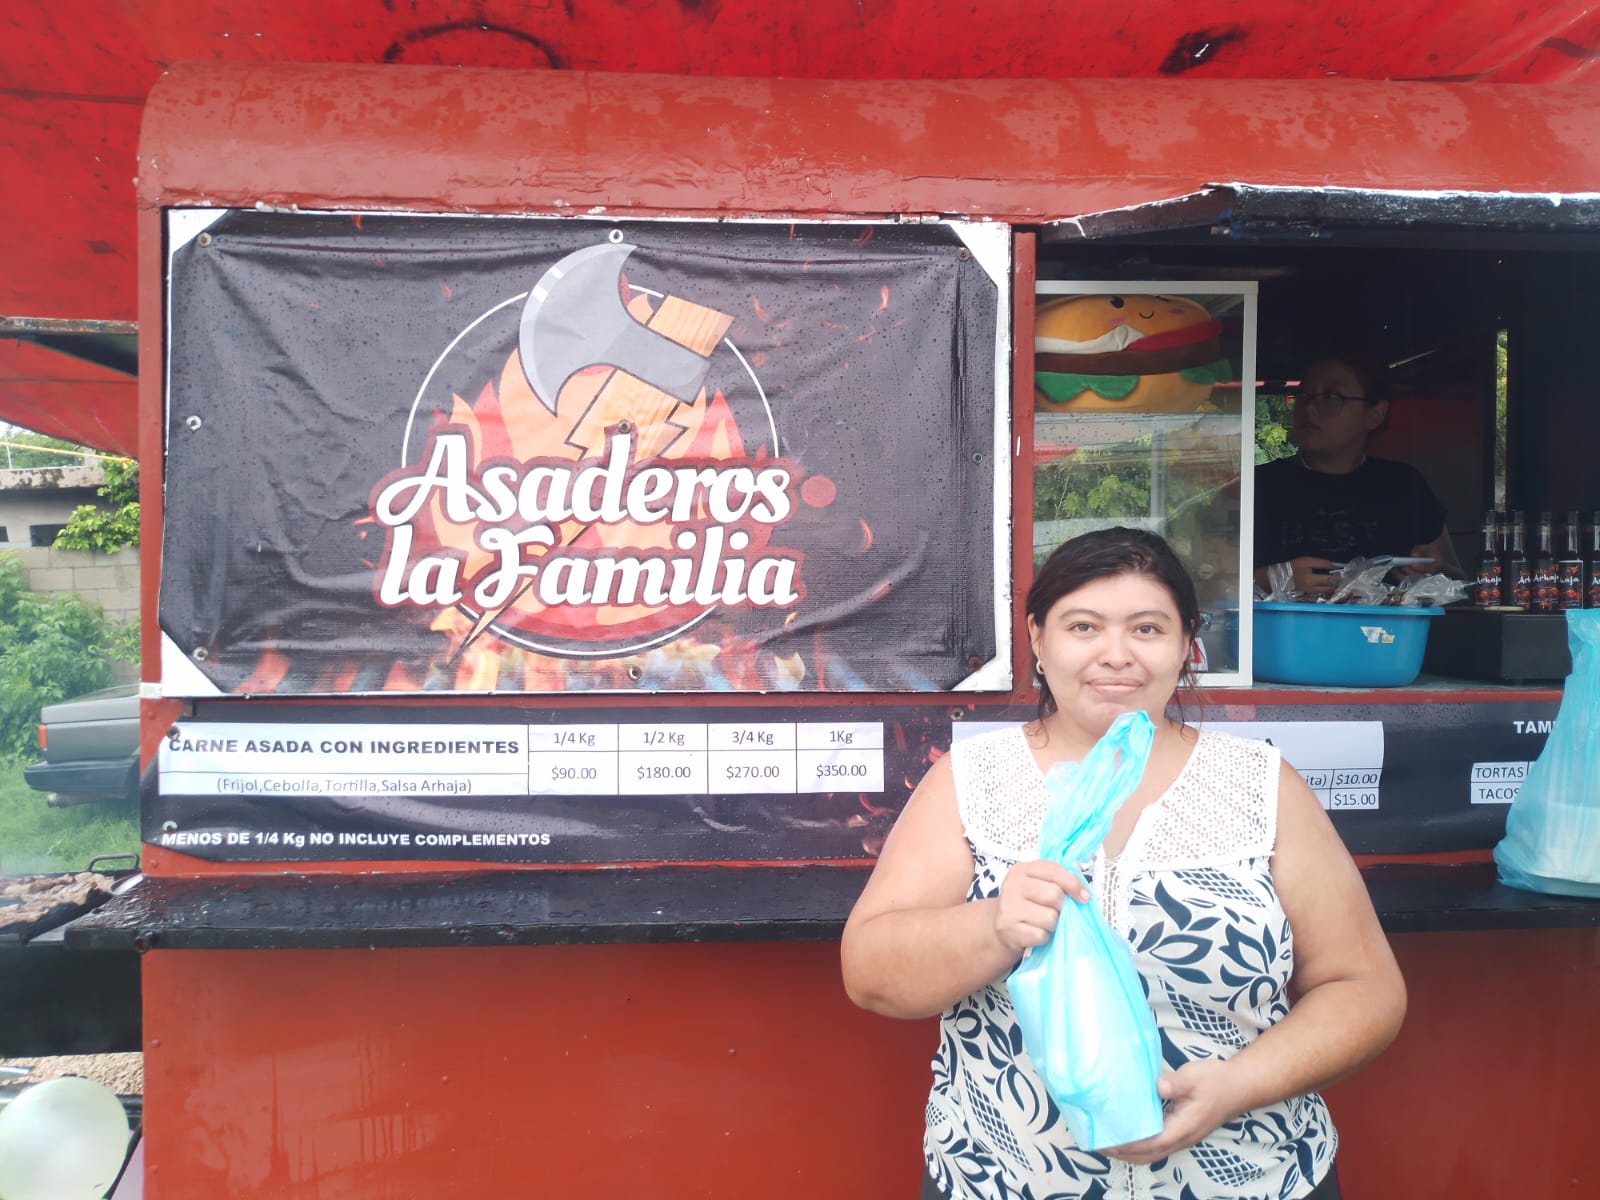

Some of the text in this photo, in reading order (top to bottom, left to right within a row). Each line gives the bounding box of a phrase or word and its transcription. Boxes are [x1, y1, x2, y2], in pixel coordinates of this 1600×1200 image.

[376, 434, 791, 525] Asaderos
[380, 525, 798, 606] la Familia
[1513, 720, 1556, 734] TAM
[553, 732, 595, 747] 1/4 Kg
[643, 732, 685, 747] 1/2 Kg
[732, 731, 774, 746] 3/4 Kg
[829, 730, 853, 745] 1Kg
[169, 738, 519, 754] CARNE ASADA CON INGREDIENTES
[551, 766, 597, 781] $90.00
[637, 765, 691, 780] $180.00
[726, 765, 780, 780] $270.00
[816, 764, 867, 779] $350.00
[1475, 766, 1524, 779] TORTAS
[420, 778, 472, 794] Arhaja)
[1336, 773, 1378, 786] $10.00
[1334, 793, 1376, 807] $15.00
[161, 832, 550, 848] MENOS DE 1/4 Kg NO INCLUYE COMPLEMENTOS
